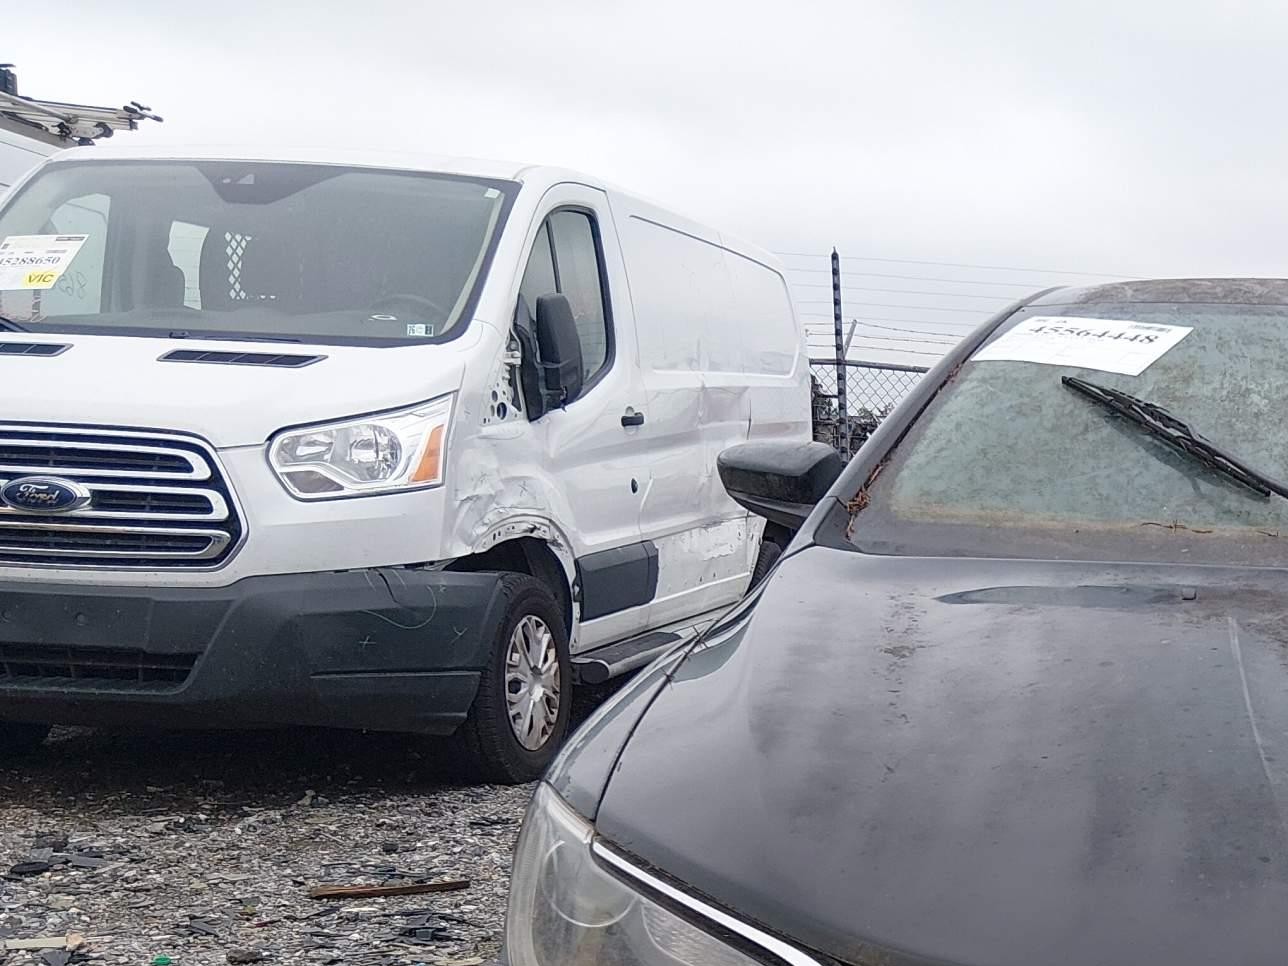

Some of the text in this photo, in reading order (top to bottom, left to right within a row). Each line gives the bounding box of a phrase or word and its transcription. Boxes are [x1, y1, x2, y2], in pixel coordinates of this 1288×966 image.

[28, 273, 54, 283] VIC
[1029, 325, 1159, 344] 45564448
[16, 483, 60, 504] Ford
